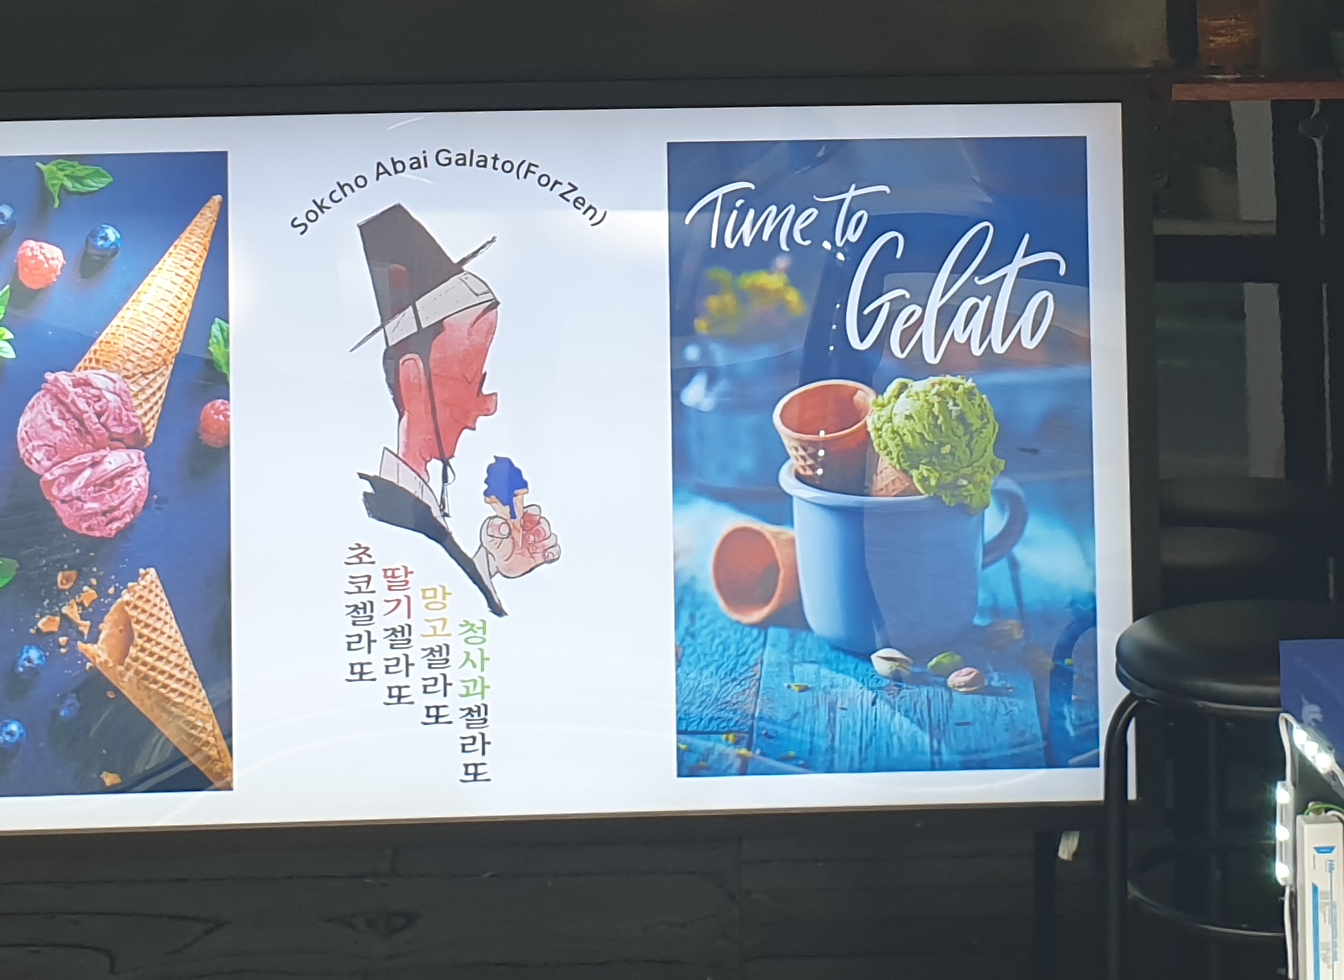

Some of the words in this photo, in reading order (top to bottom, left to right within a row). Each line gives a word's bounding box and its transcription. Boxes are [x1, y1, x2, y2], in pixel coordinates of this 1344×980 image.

[290, 172, 370, 237] Sokcho
[373, 148, 429, 182] Abai
[685, 180, 815, 250] Time
[814, 182, 891, 246] to
[844, 220, 1067, 366] Gelato
[343, 541, 378, 685] 초코젤라또
[381, 563, 416, 708] 딸기젤라또
[419, 584, 455, 728] 망고젤라또
[458, 618, 493, 785] 청사과젤라또
